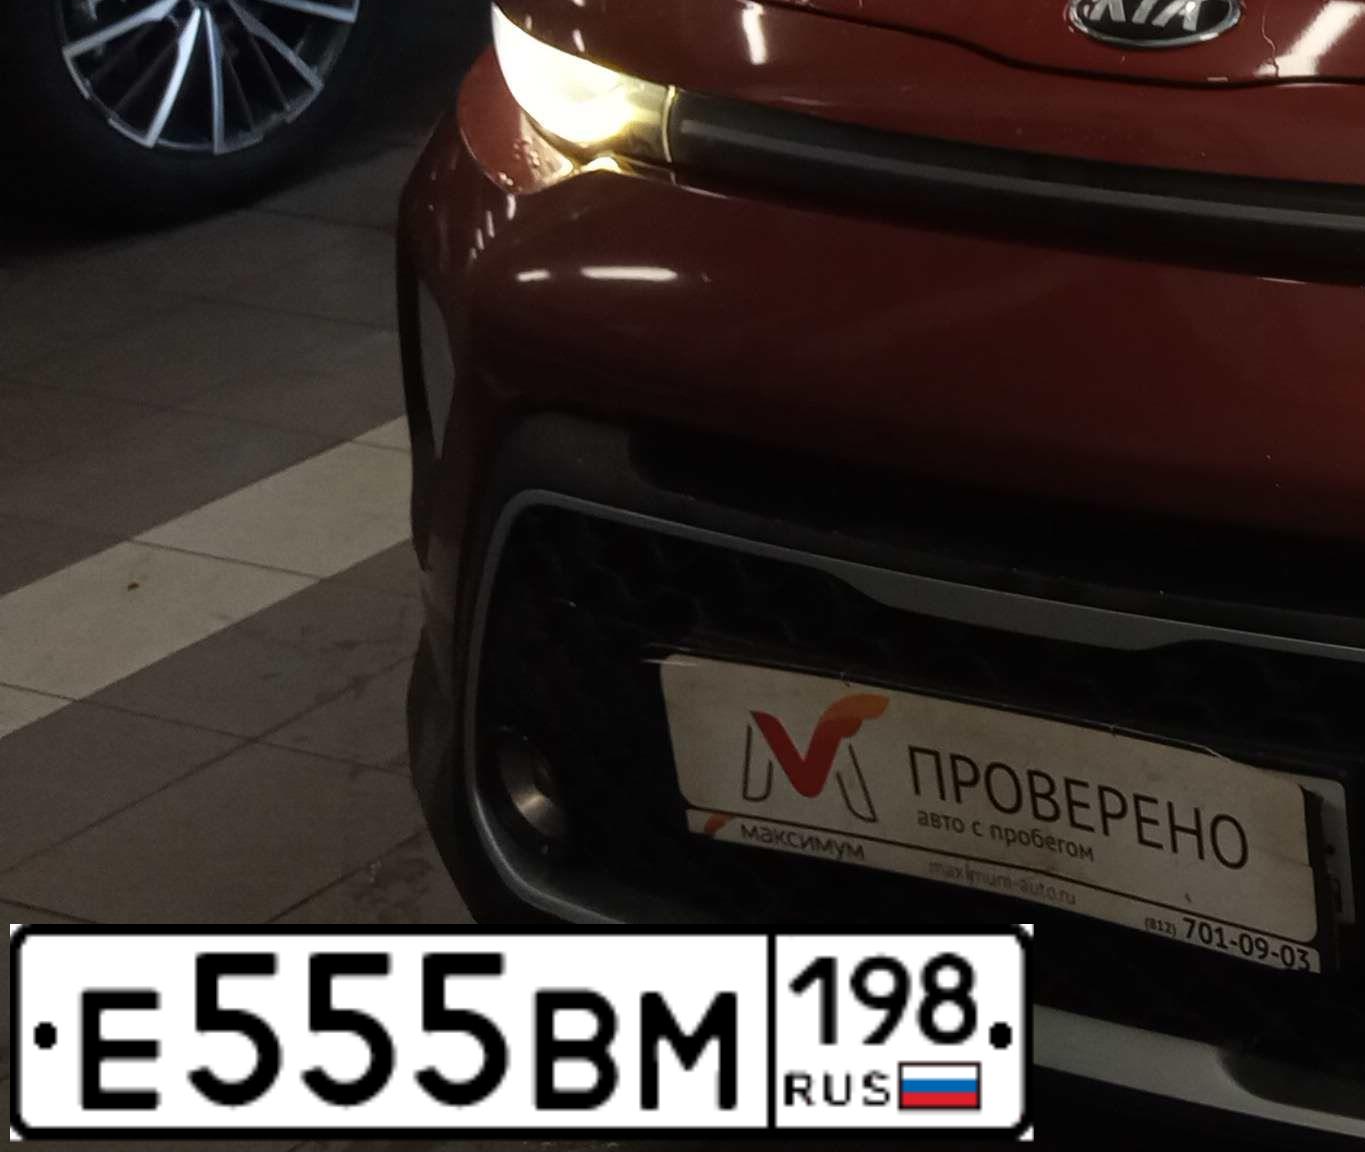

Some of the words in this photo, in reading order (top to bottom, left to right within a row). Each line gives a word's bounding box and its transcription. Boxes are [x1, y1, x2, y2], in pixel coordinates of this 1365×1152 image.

[907, 745, 1250, 870] ПРОВЕРЕНО
[740, 824, 866, 862] максимум
[916, 808, 961, 837] авто
[972, 820, 983, 838] с
[990, 821, 1095, 862] пробегом
[928, 860, 1077, 905] maximum-auto.ru
[1144, 917, 1177, 937] (812)
[1182, 917, 1312, 972] 701-09-03
